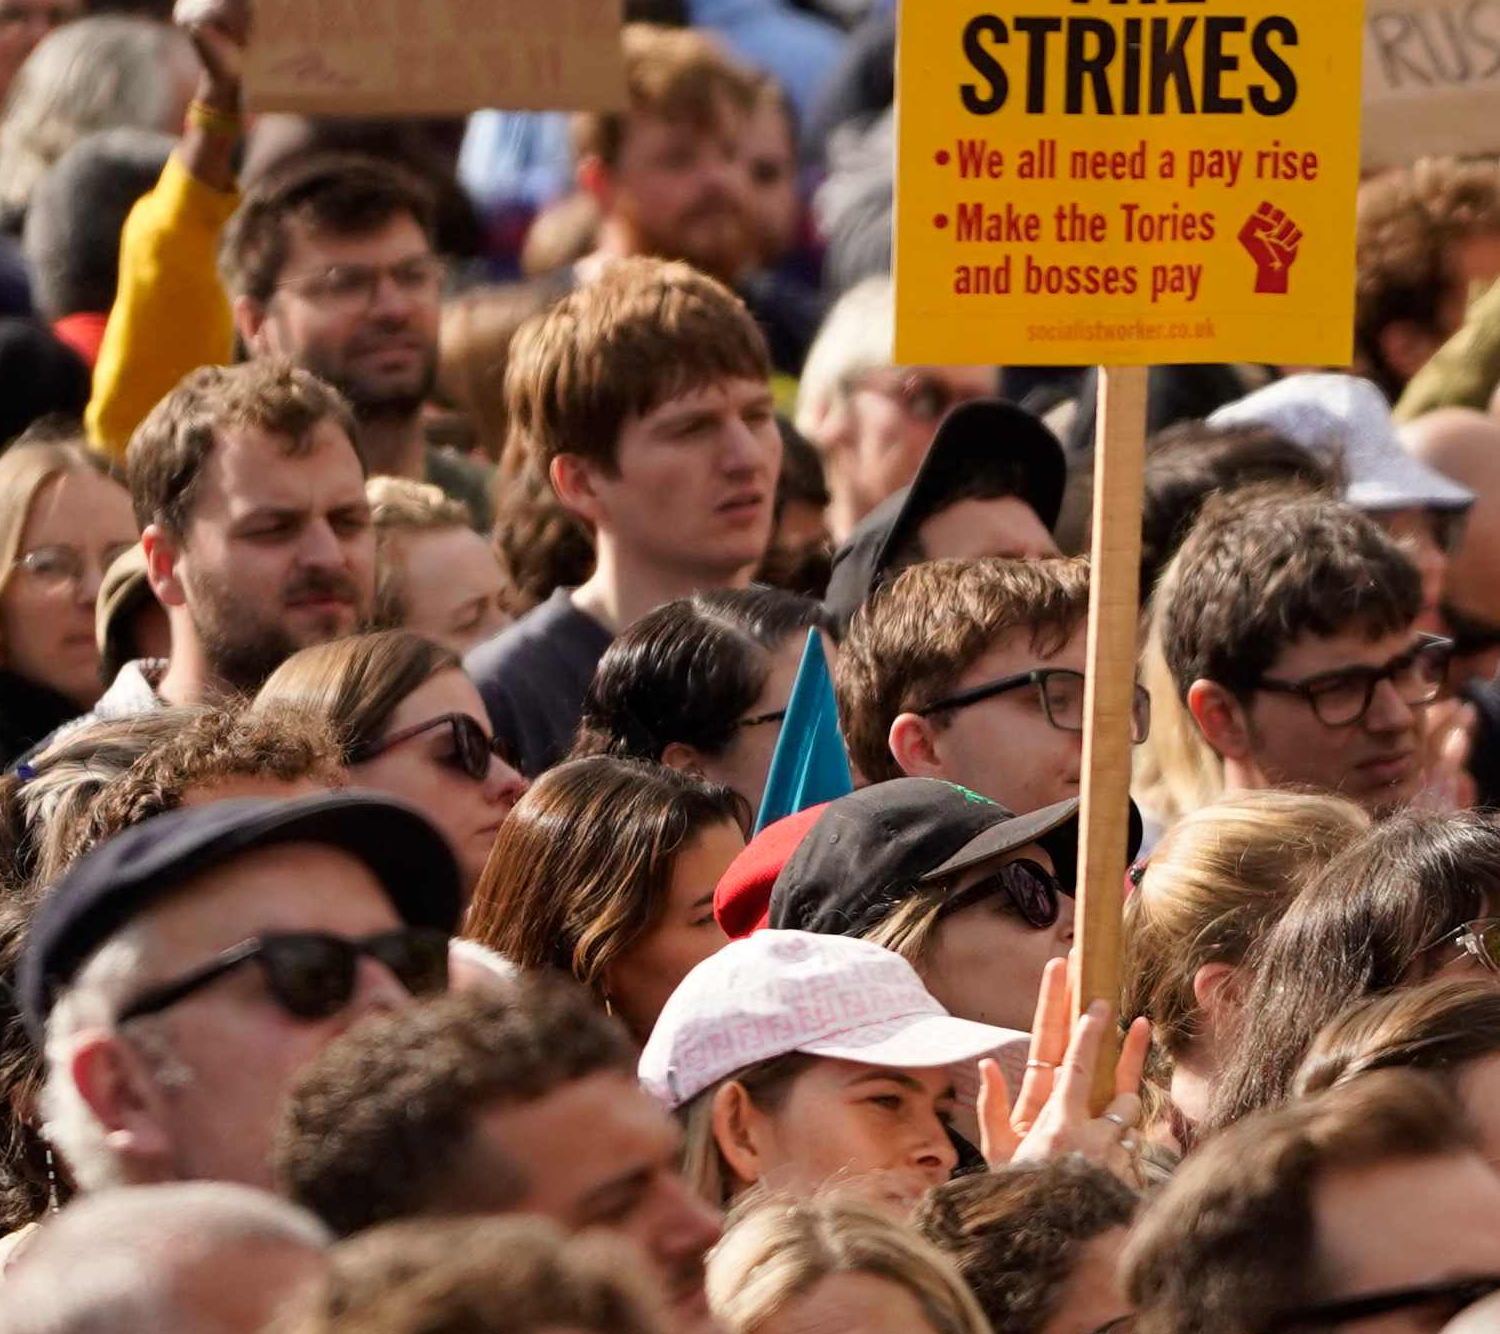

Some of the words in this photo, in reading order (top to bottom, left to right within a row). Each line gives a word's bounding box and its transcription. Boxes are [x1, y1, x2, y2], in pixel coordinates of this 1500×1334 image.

[959, 14, 1299, 117] STRIKES
[956, 139, 1003, 180] We
[1017, 139, 1056, 180] all
[1070, 140, 1146, 180] need
[1158, 151, 1175, 180] a
[1188, 149, 1243, 188] pay
[1255, 141, 1319, 181] rise
[956, 202, 1041, 243] Make
[1054, 203, 1107, 243] the
[1121, 202, 1216, 242] Tories
[954, 254, 1011, 295] and
[1024, 254, 1138, 296] bosses
[1151, 264, 1203, 304] pay
[1026, 319, 1216, 343] socialistworker.co.uk
